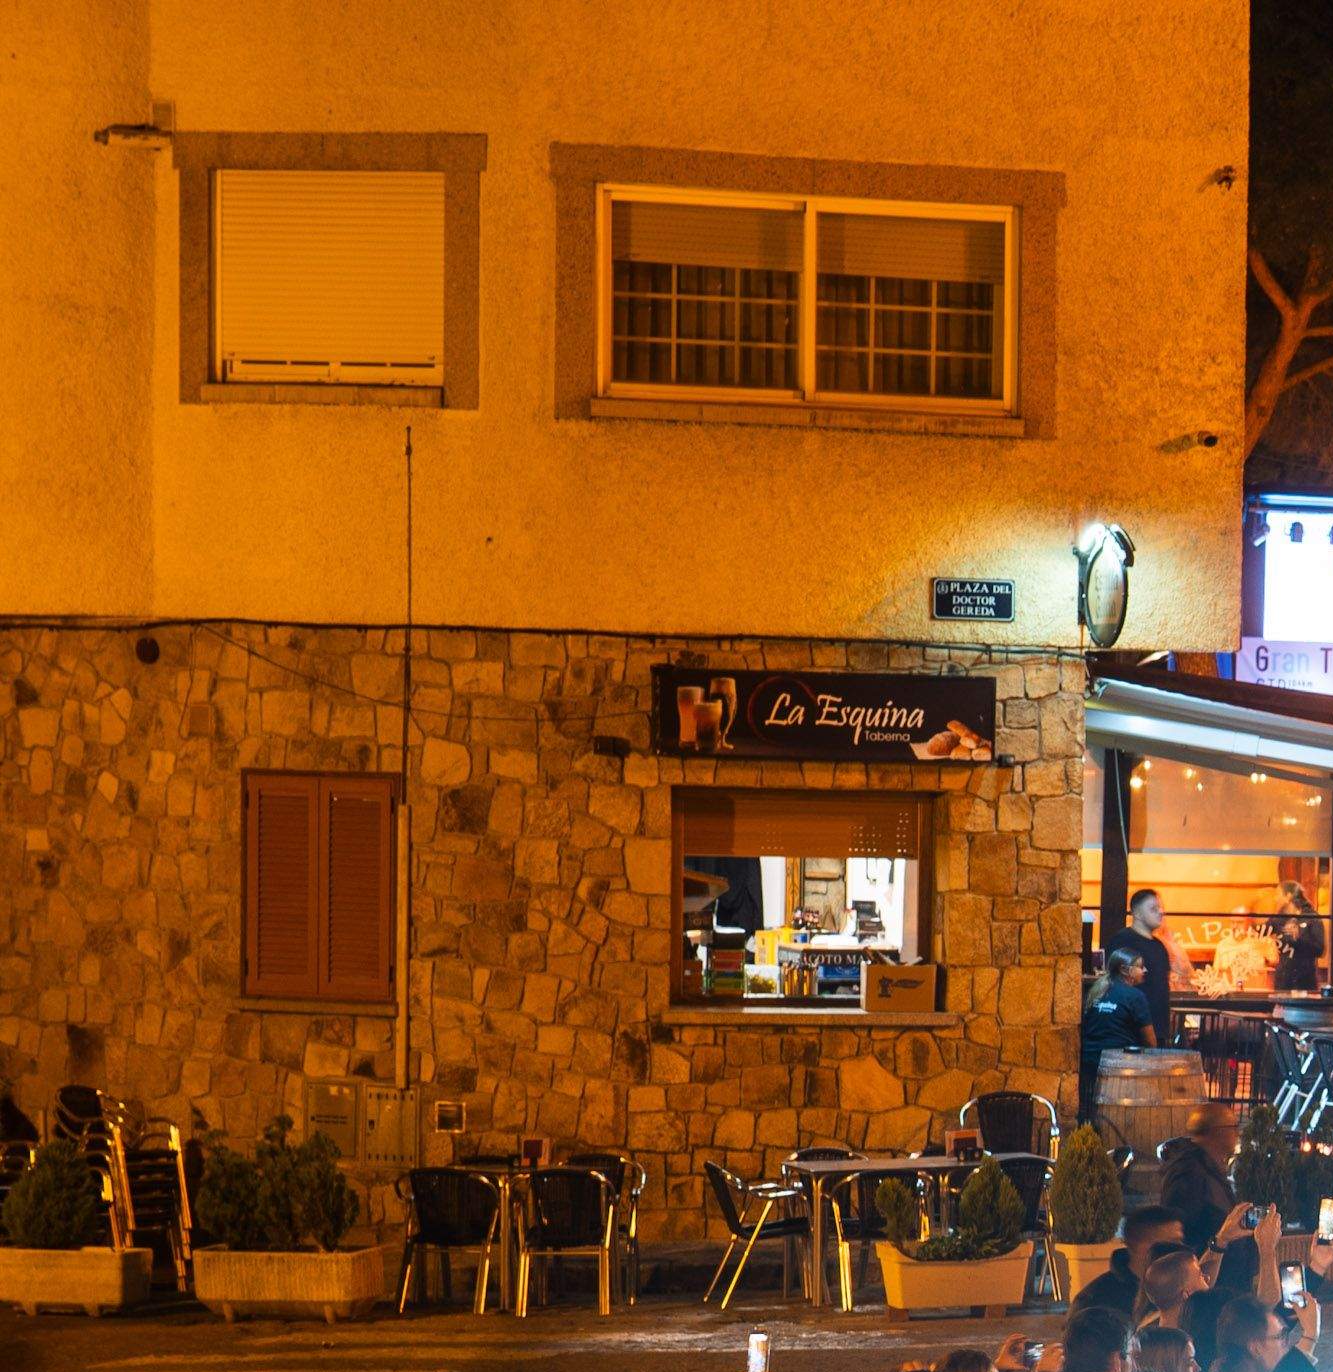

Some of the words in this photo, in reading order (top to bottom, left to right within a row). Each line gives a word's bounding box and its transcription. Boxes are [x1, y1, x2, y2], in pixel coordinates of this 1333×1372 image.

[950, 582, 988, 594] PLAZA
[992, 585, 1012, 595] DEL
[952, 595, 996, 606] DOCTOR
[952, 606, 996, 617] GEREDA
[1255, 645, 1310, 672] Gran
[765, 692, 805, 727] La
[814, 693, 925, 745] Esquina
[864, 730, 910, 742] Taberna
